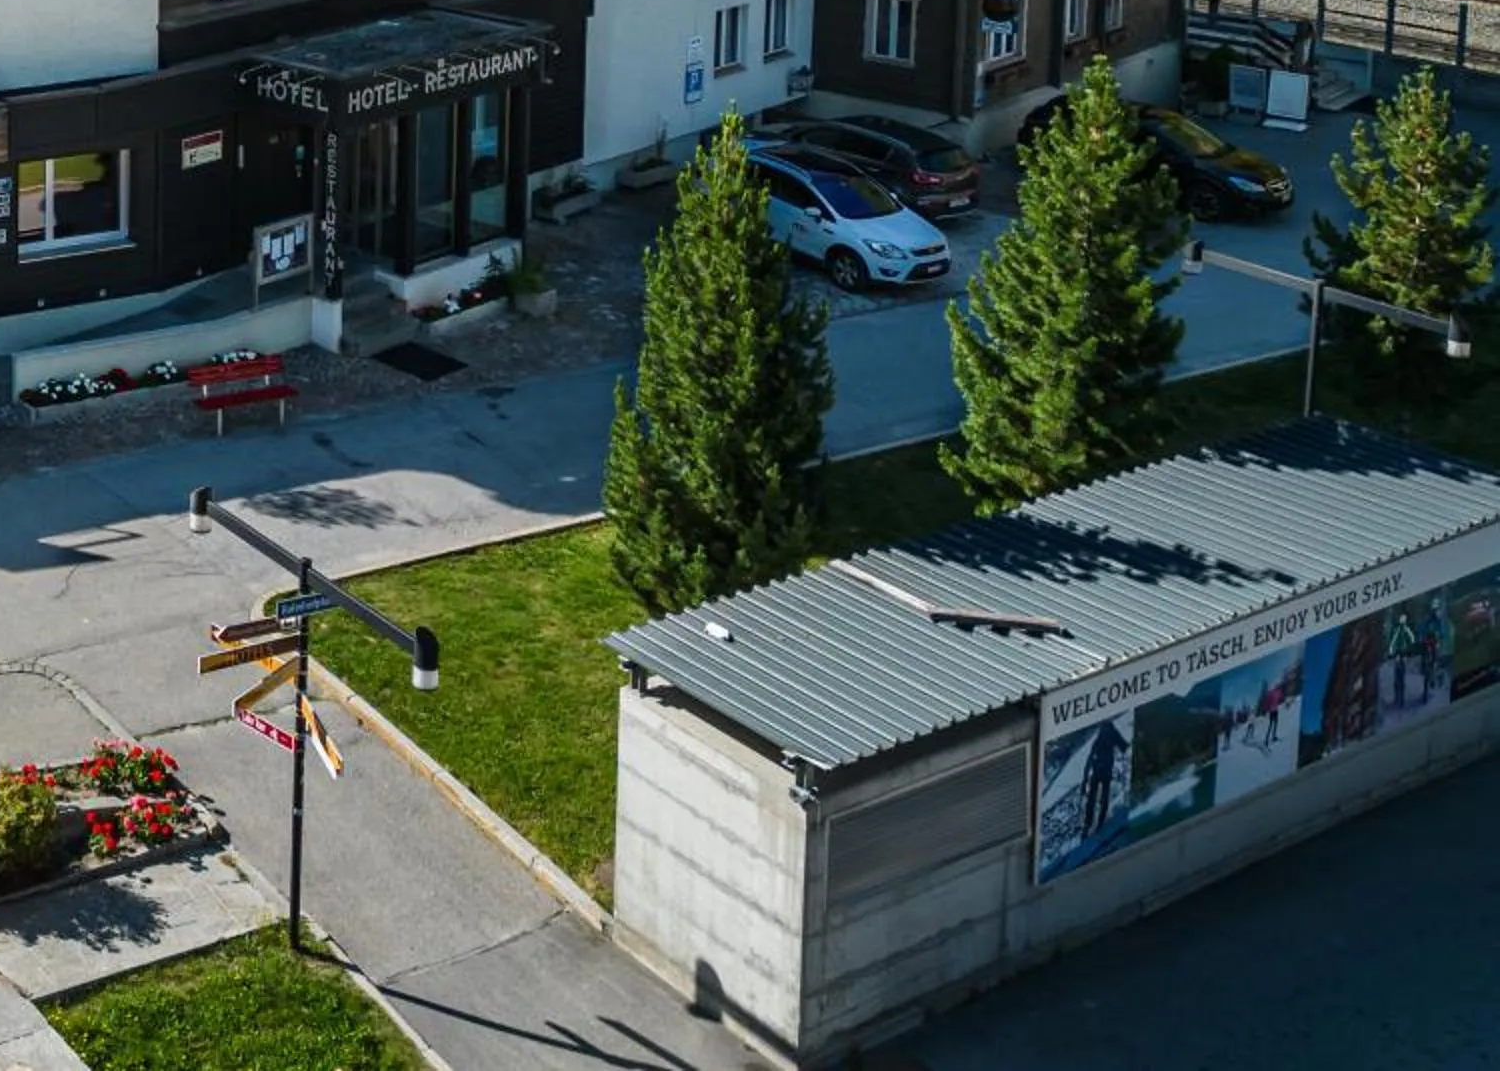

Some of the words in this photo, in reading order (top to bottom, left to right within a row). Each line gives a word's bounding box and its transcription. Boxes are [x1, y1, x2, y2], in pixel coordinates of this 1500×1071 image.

[257, 75, 329, 112] HOTEL
[425, 48, 536, 94] RESTAURANT
[324, 132, 338, 287] RESTAURANT
[1050, 678, 1153, 726] WELCOME
[1155, 660, 1182, 686] TO
[1252, 610, 1311, 648] ENJOY
[1311, 589, 1359, 625] YOUR
[1362, 573, 1406, 606] STAY.
